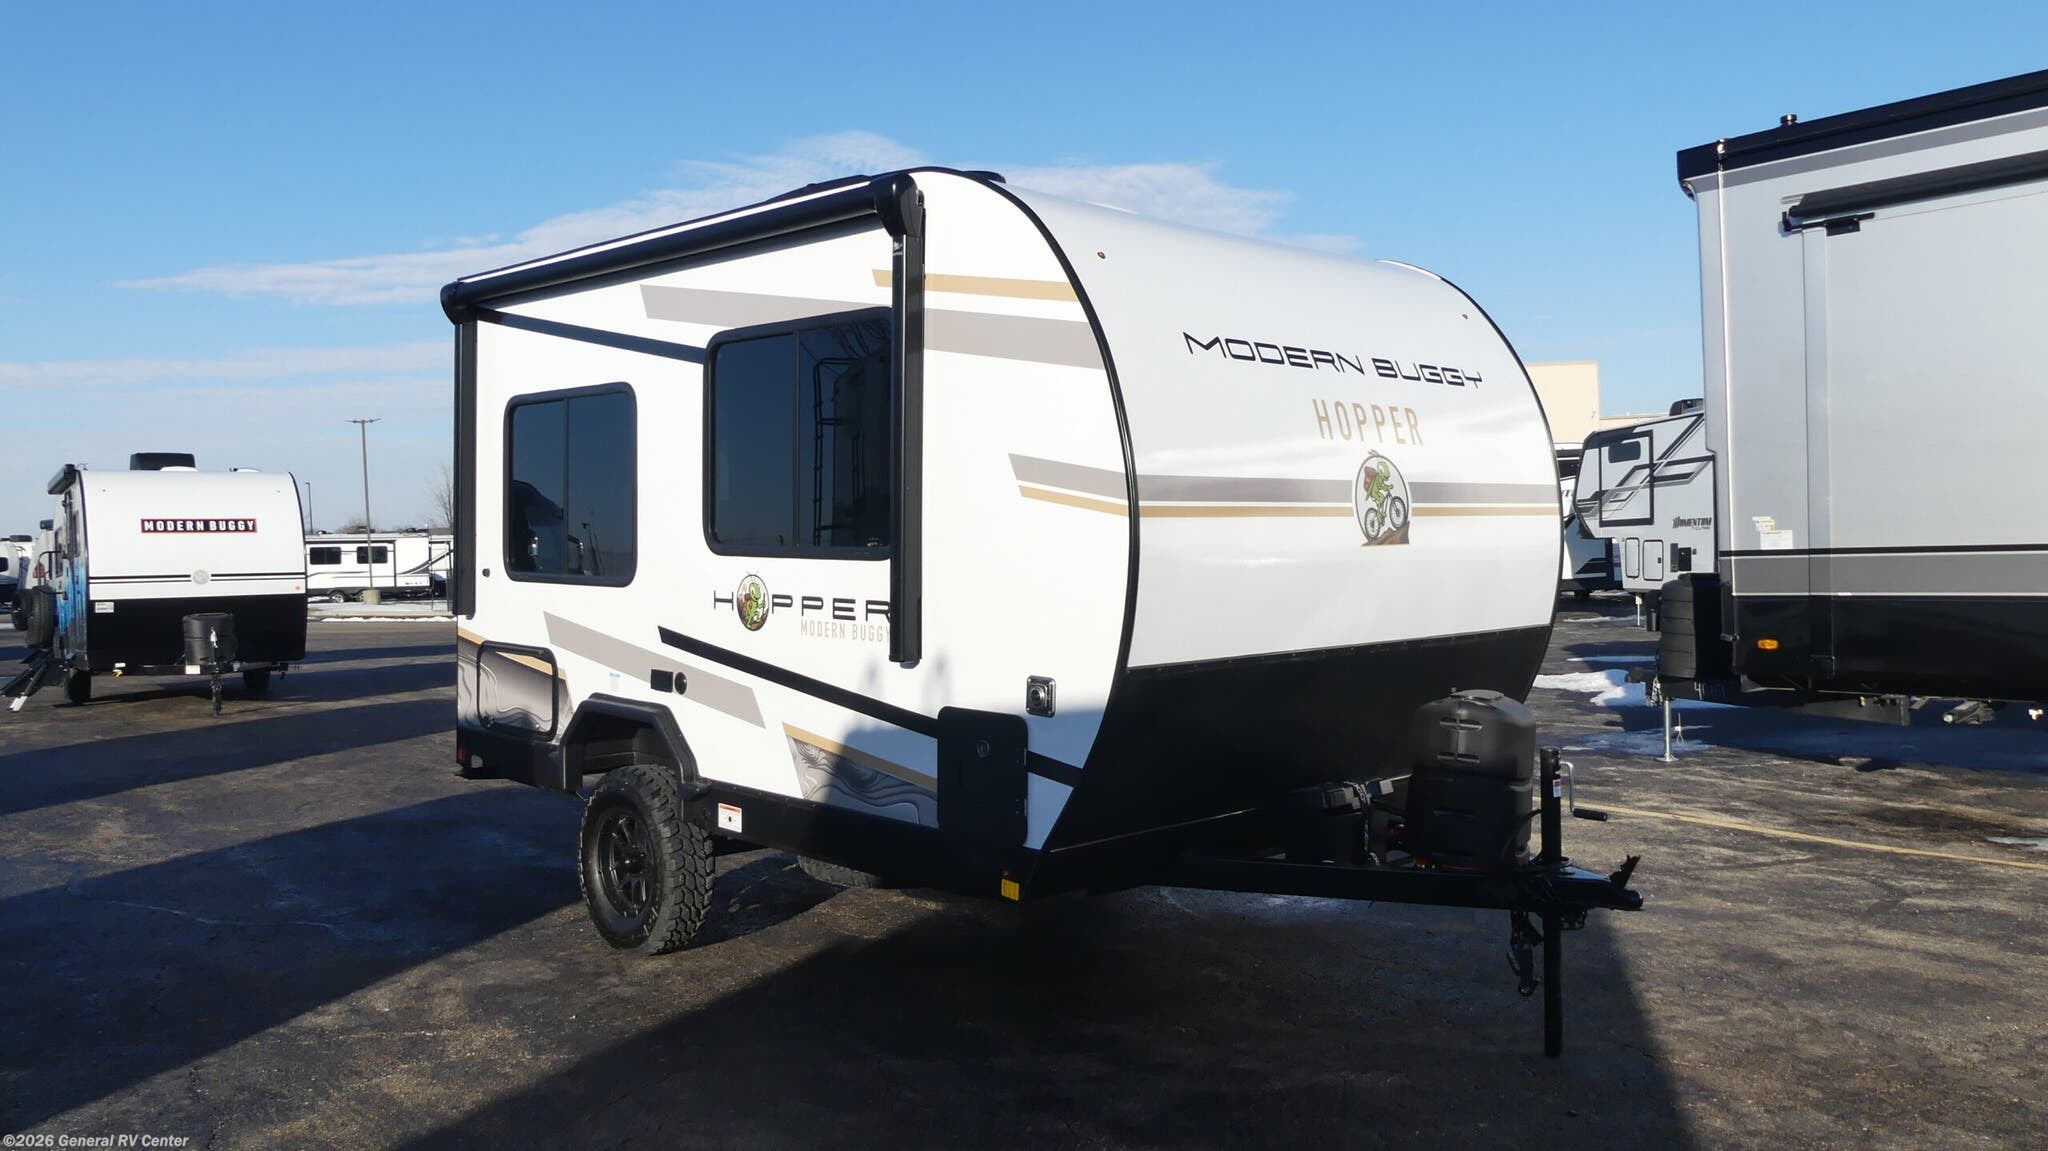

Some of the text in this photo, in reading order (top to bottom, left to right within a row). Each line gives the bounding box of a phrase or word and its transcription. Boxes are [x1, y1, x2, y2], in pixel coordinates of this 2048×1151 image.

[1183, 331, 1483, 388] MODERN BUGGY
[1312, 397, 1424, 446] HOPPER
[143, 520, 254, 531] MODERN BUGGY
[800, 619, 846, 639] MODERN
